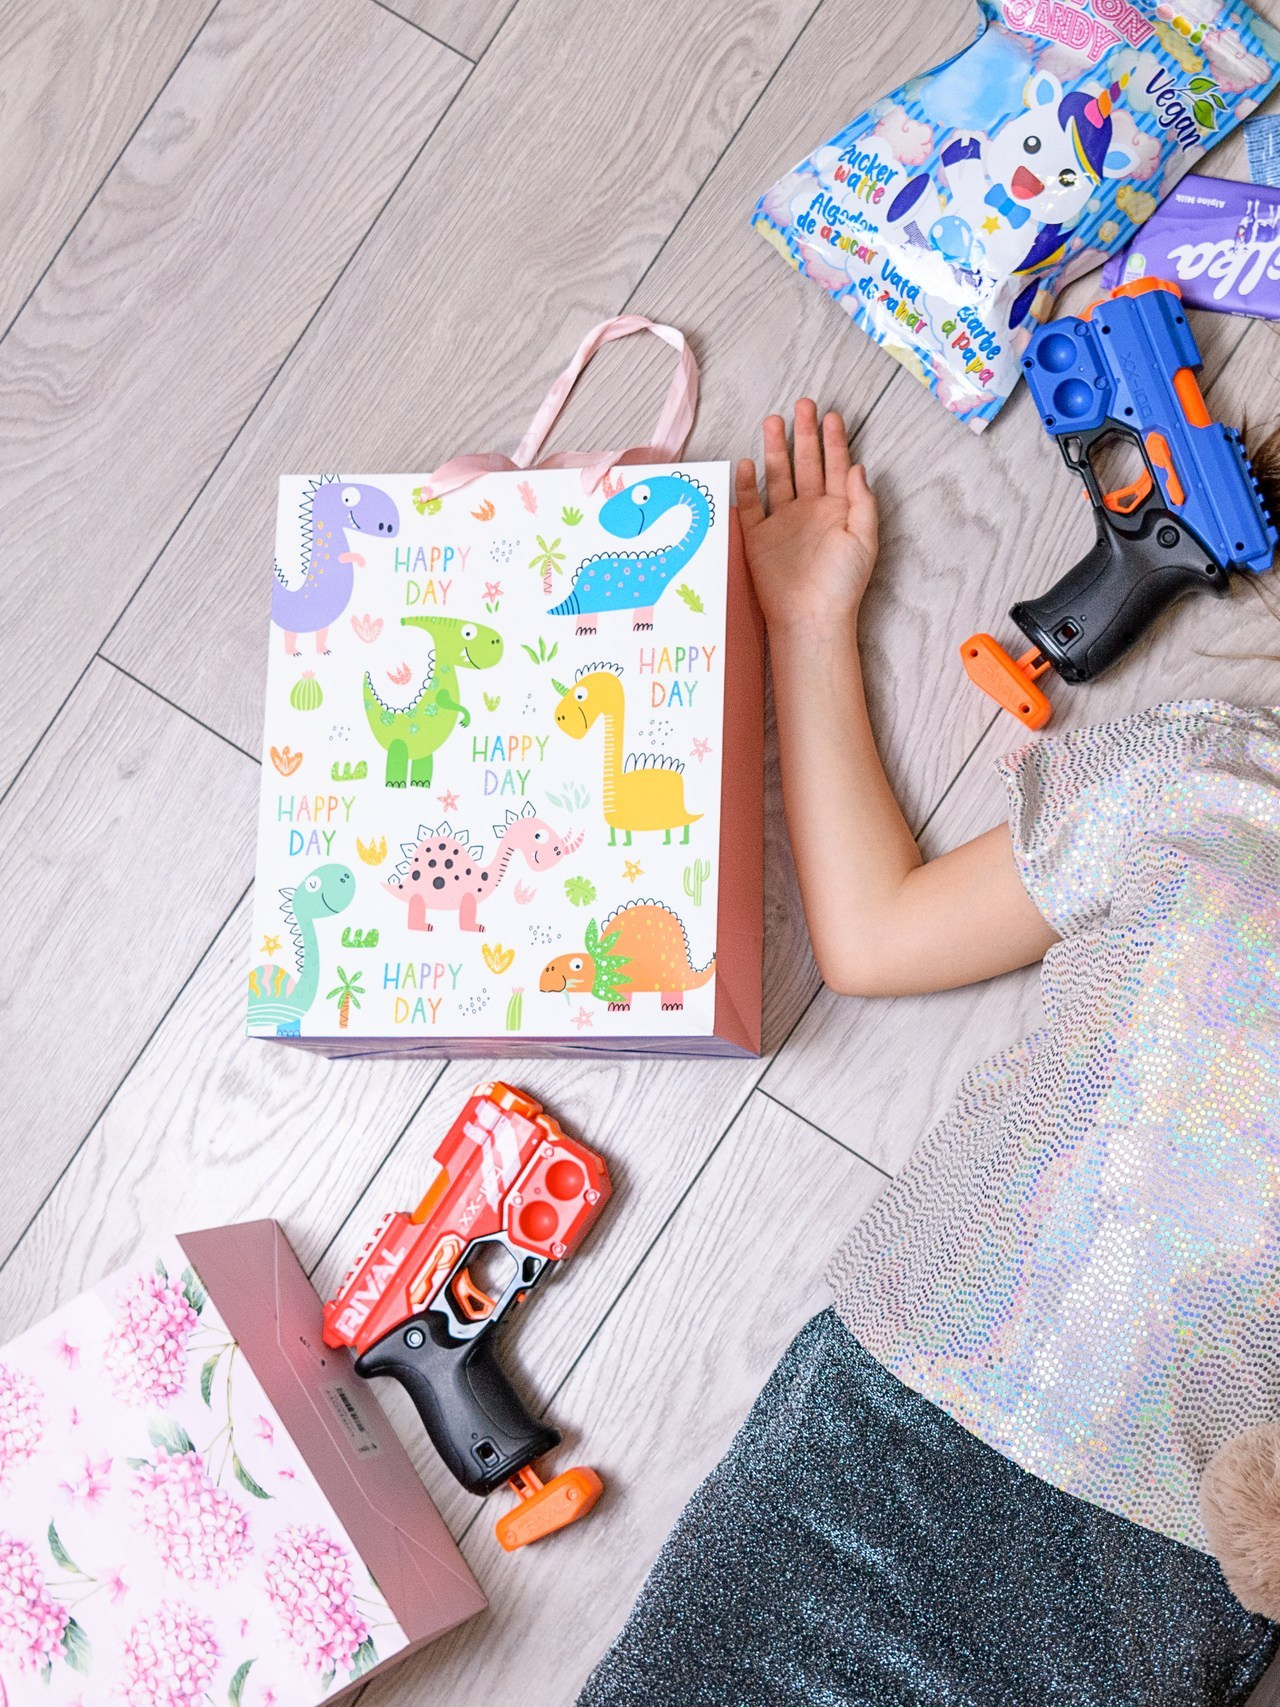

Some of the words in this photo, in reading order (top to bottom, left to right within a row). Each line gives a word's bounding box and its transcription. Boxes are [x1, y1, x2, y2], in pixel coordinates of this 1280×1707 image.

[1003, 0, 1122, 62] CANDY
[1146, 68, 1201, 152] Vegan
[1175, 194, 1196, 204] Milk
[1196, 197, 1225, 208] Alpine
[797, 211, 816, 235] de
[859, 276, 879, 300] de
[952, 331, 995, 387] papa
[393, 546, 471, 573] HAPPY
[405, 579, 453, 606] DAY
[639, 645, 716, 675] HAPPY
[651, 680, 699, 708] DAY
[472, 734, 550, 763] HAPPY
[483, 769, 532, 797] DAY
[277, 794, 356, 823] HAPPY
[289, 829, 336, 857] DAY
[382, 962, 464, 991] HAPPY
[394, 996, 443, 1025] DAY
[334, 1244, 406, 1339] RIVAL
